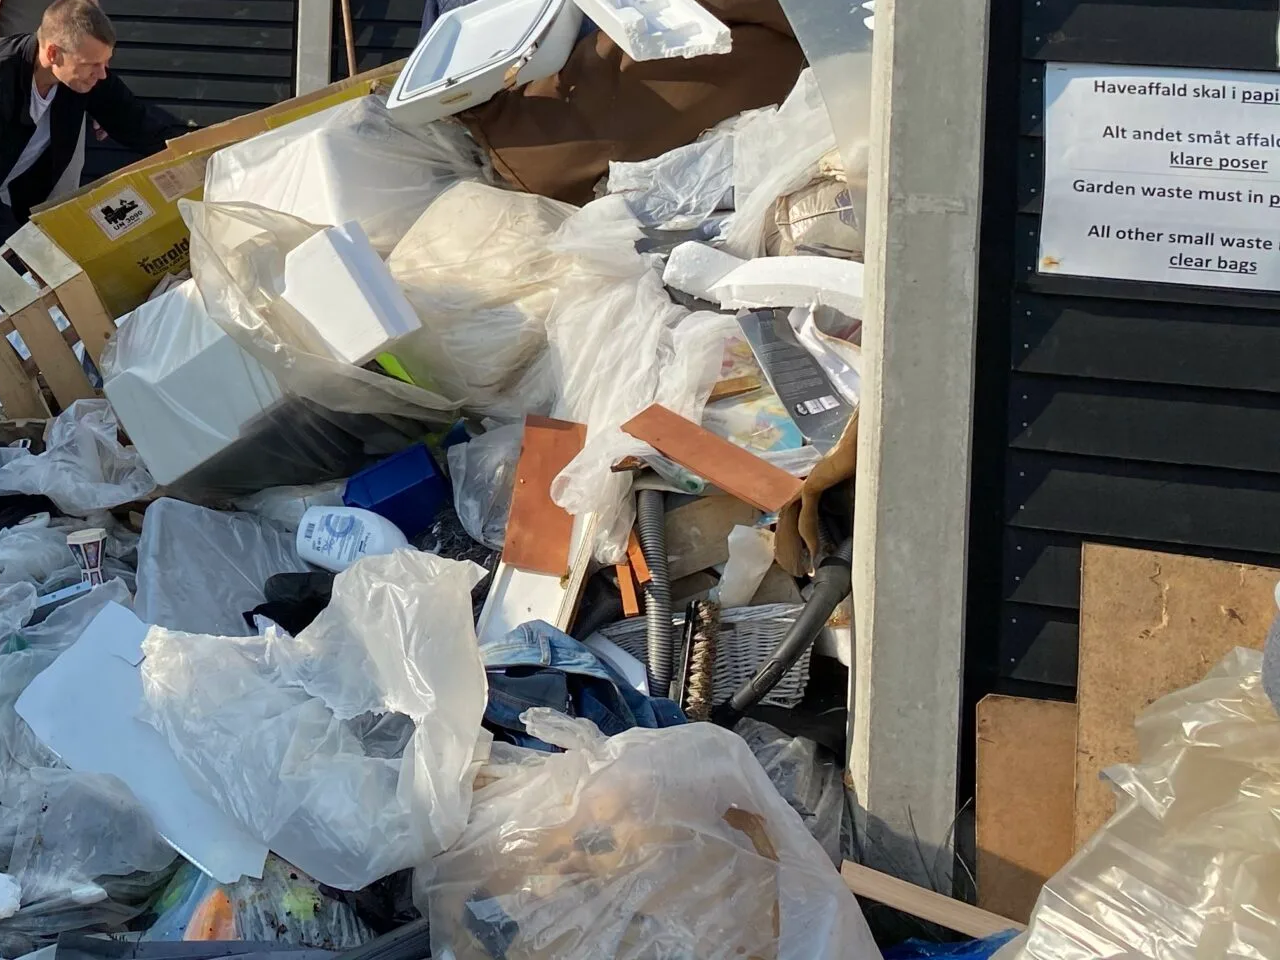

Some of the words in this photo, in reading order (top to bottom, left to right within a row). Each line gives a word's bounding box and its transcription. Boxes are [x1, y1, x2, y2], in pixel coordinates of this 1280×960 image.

[1093, 80, 1188, 97] Haveaffald
[1192, 85, 1226, 99] skal
[1231, 86, 1237, 100] i
[1242, 89, 1280, 105] papi
[1102, 125, 1127, 140] Alt
[1132, 128, 1183, 143] andet
[1187, 130, 1231, 145] småt
[1169, 151, 1213, 167] klare
[1219, 157, 1269, 173] poser
[1072, 179, 1136, 196] Garden
[1141, 185, 1193, 199] waste
[1198, 189, 1242, 203] must
[1248, 189, 1264, 204] in
[113, 221, 125, 231] UN
[1087, 225, 1110, 238] All
[1115, 227, 1164, 243] other
[1168, 232, 1215, 247] small
[1220, 236, 1273, 250] waste
[1169, 252, 1212, 269] clear
[1217, 256, 1258, 274] bags
